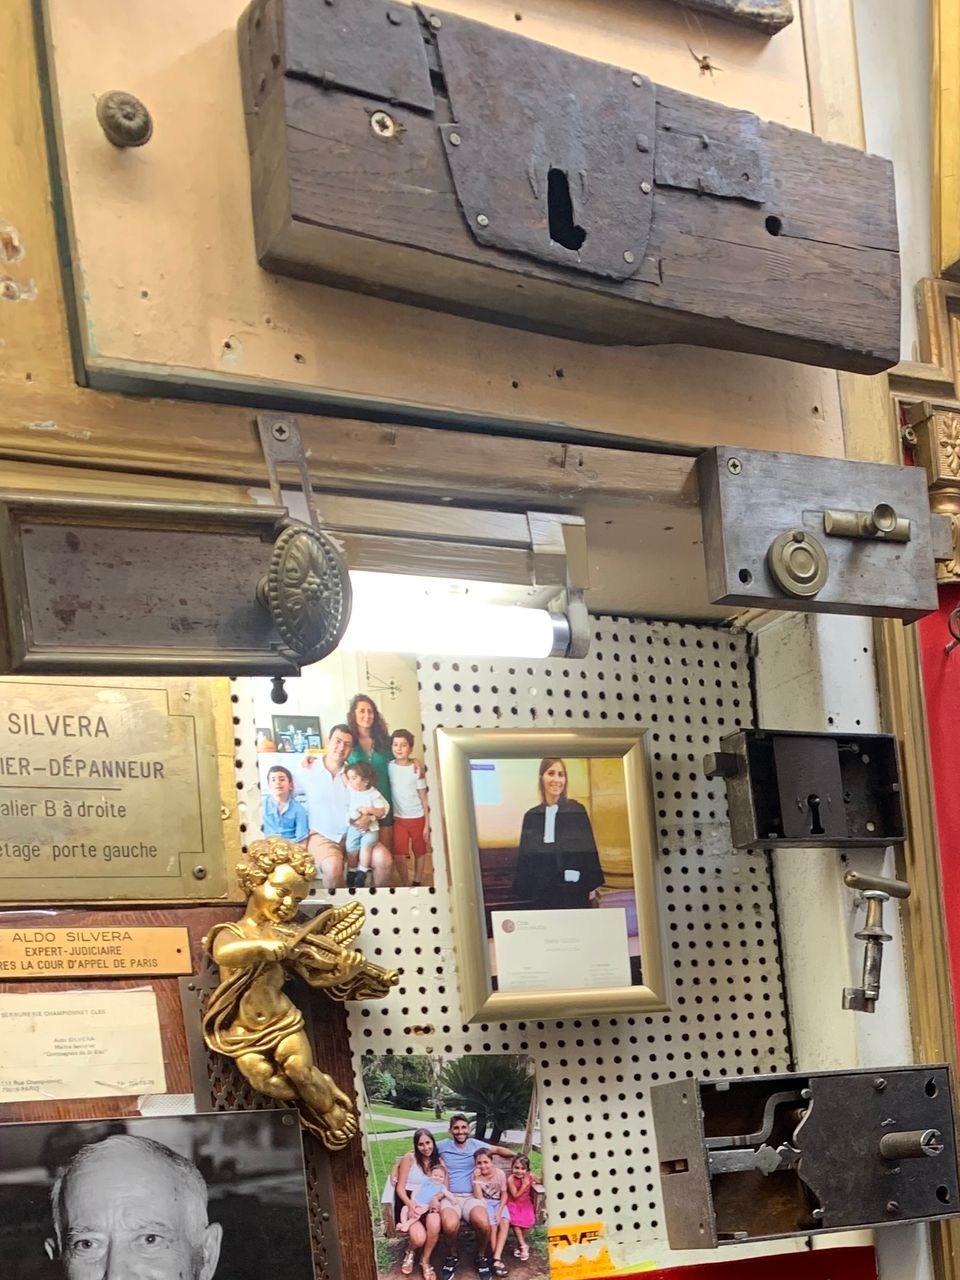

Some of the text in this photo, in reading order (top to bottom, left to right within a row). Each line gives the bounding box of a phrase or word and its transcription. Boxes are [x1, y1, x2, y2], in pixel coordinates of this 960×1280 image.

[8, 712, 110, 738] SILVERA
[1, 800, 127, 818] alier B à droite
[52, 844, 97, 862] porte
[103, 842, 157, 862] gauche
[12, 931, 133, 943] ALDO SILVERA
[25, 946, 122, 957] EXPERT-JUDICIAIRE
[20, 960, 34, 970] LA
[37, 960, 64, 970] COUR
[68, 959, 109, 969] D'APPEL
[113, 958, 126, 968] DE
[130, 958, 158, 968] PARIS
